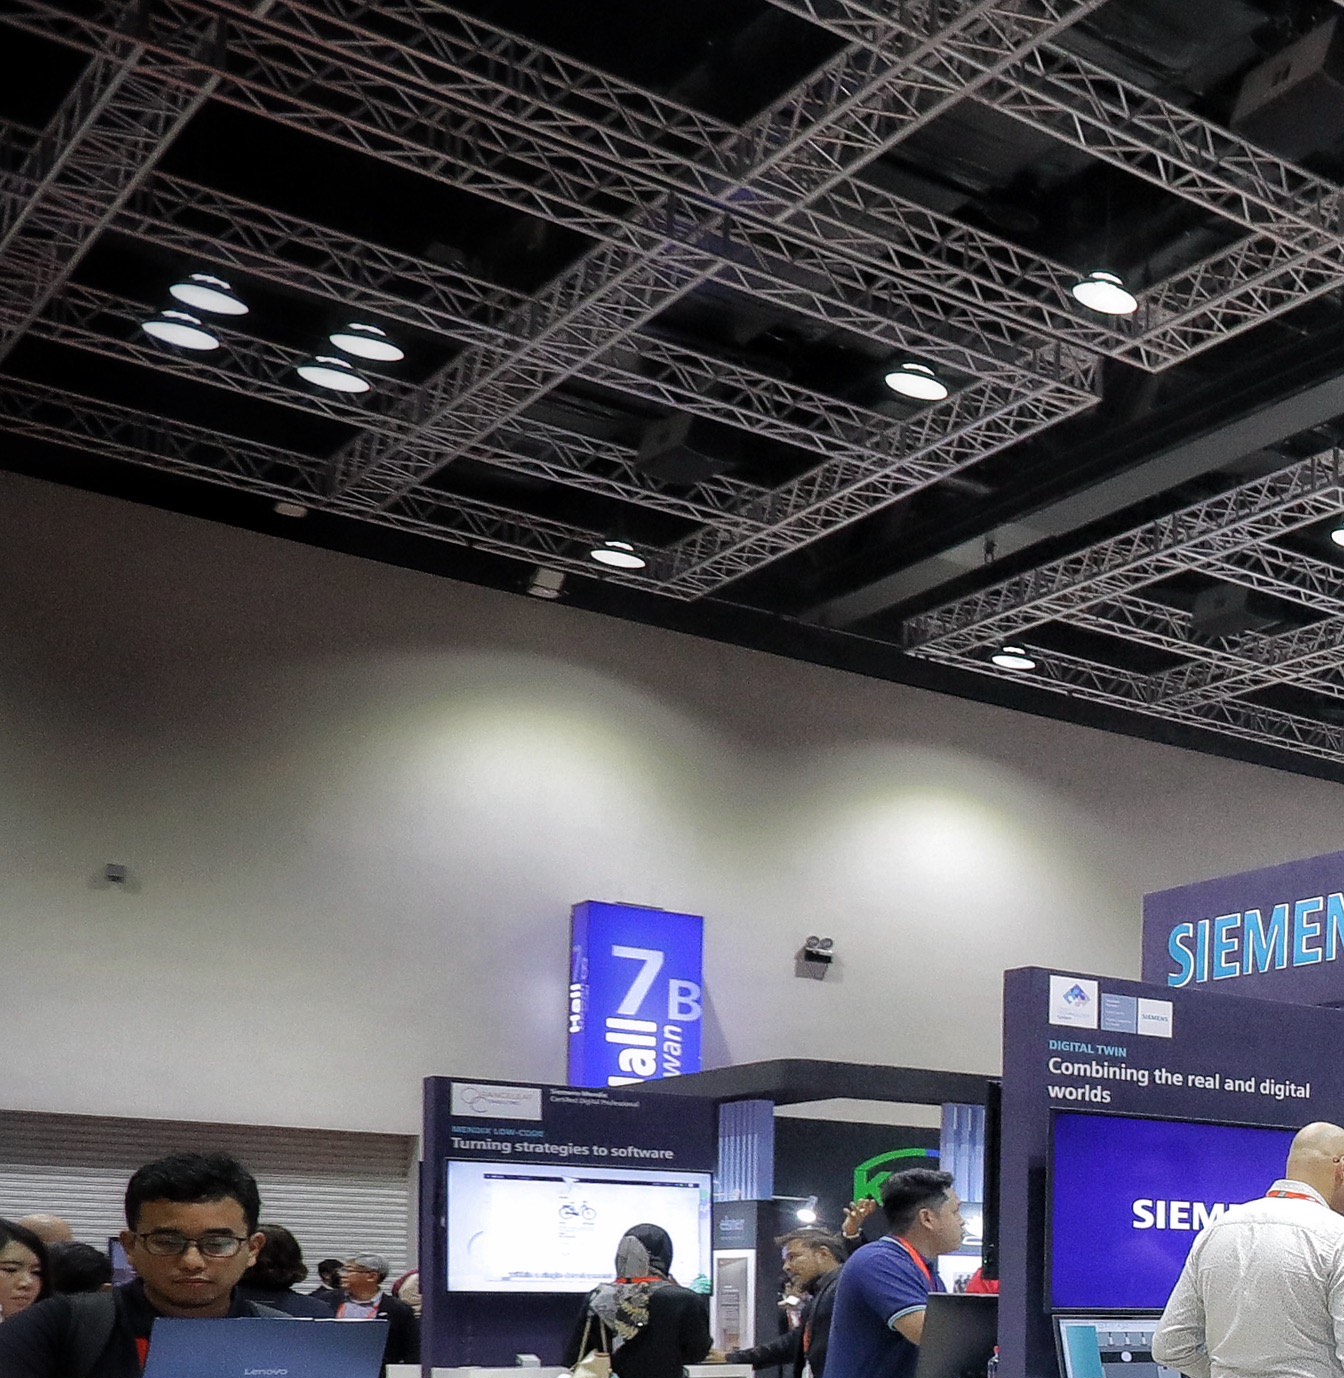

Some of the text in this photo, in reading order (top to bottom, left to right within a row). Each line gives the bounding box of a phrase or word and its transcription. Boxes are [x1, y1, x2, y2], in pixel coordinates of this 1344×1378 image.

[1049, 1040, 1127, 1057] DIGITAL TWIN
[1048, 1057, 1311, 1101] Combining the real and digital
[1048, 1084, 1111, 1103] worlds
[451, 1137, 675, 1159] Turning strategies to software
[1132, 1198, 1225, 1230] SIEM
